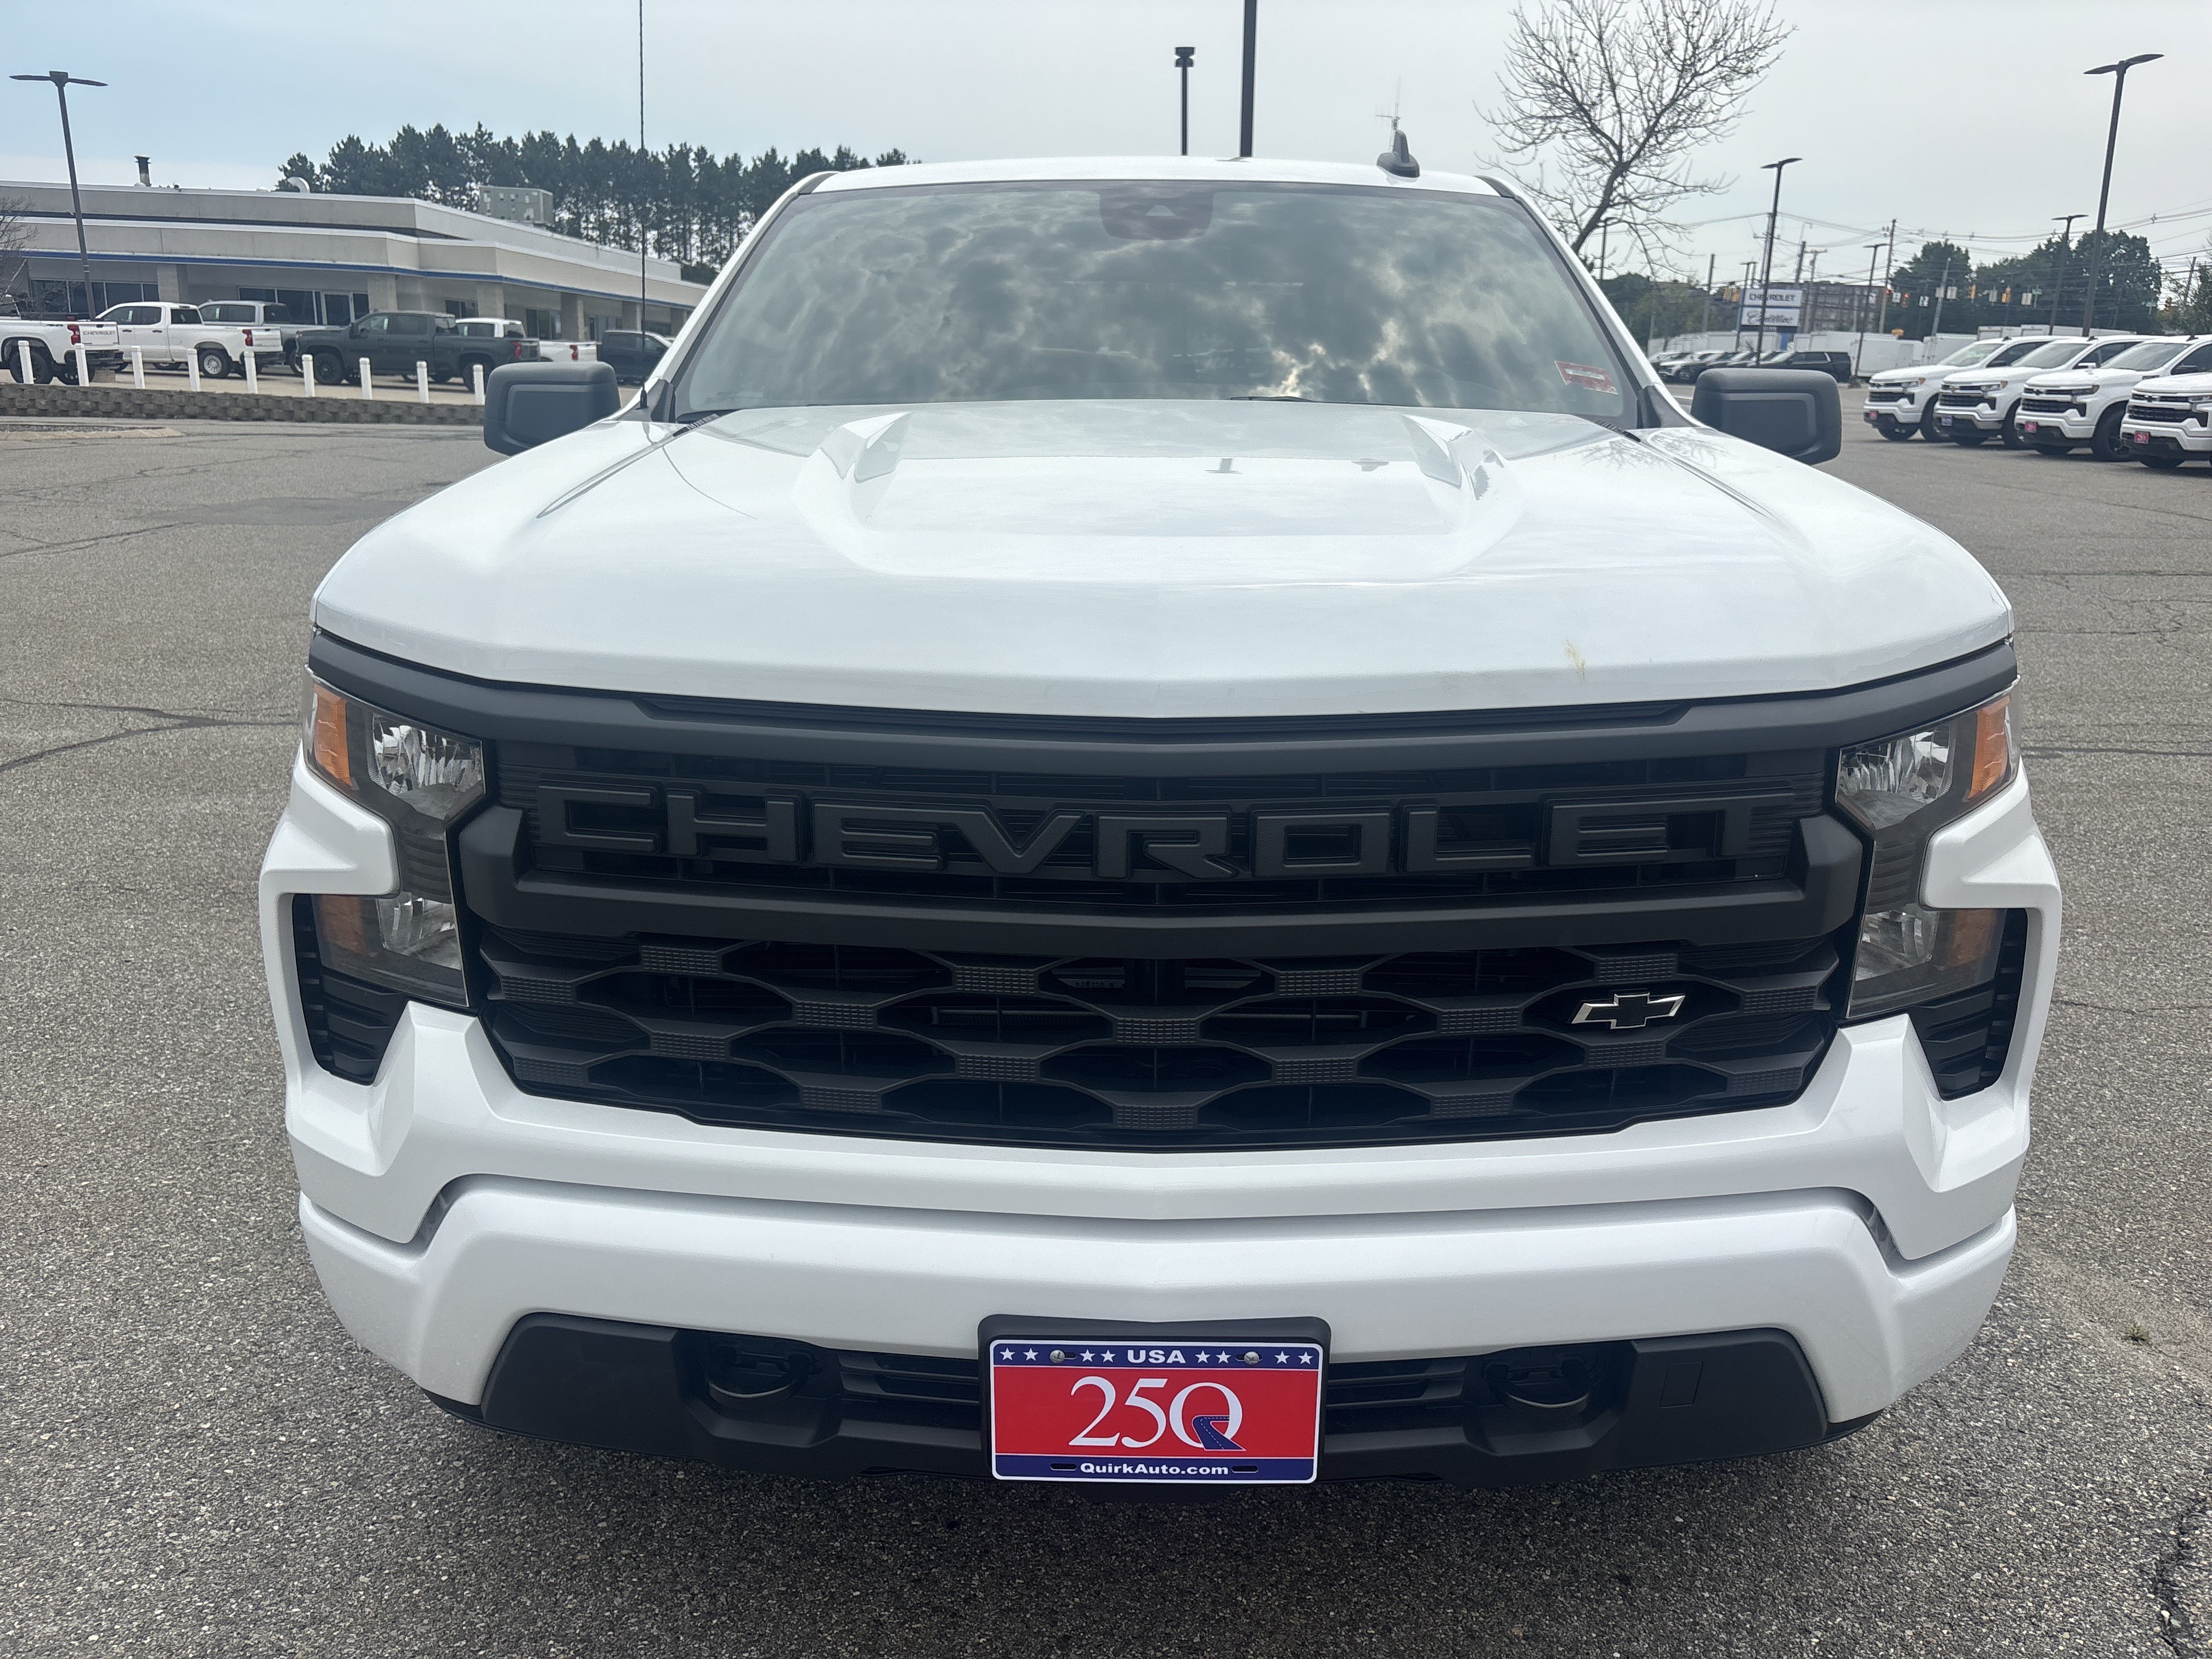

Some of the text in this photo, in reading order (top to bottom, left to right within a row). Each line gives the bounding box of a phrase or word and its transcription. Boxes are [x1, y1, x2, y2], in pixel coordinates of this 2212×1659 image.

[1746, 309, 1793, 324] Cdillac
[539, 785, 1794, 879] CHEVROLET
[1128, 1350, 1186, 1363] USA
[1081, 1463, 1228, 1474] QuirkAuto.com
